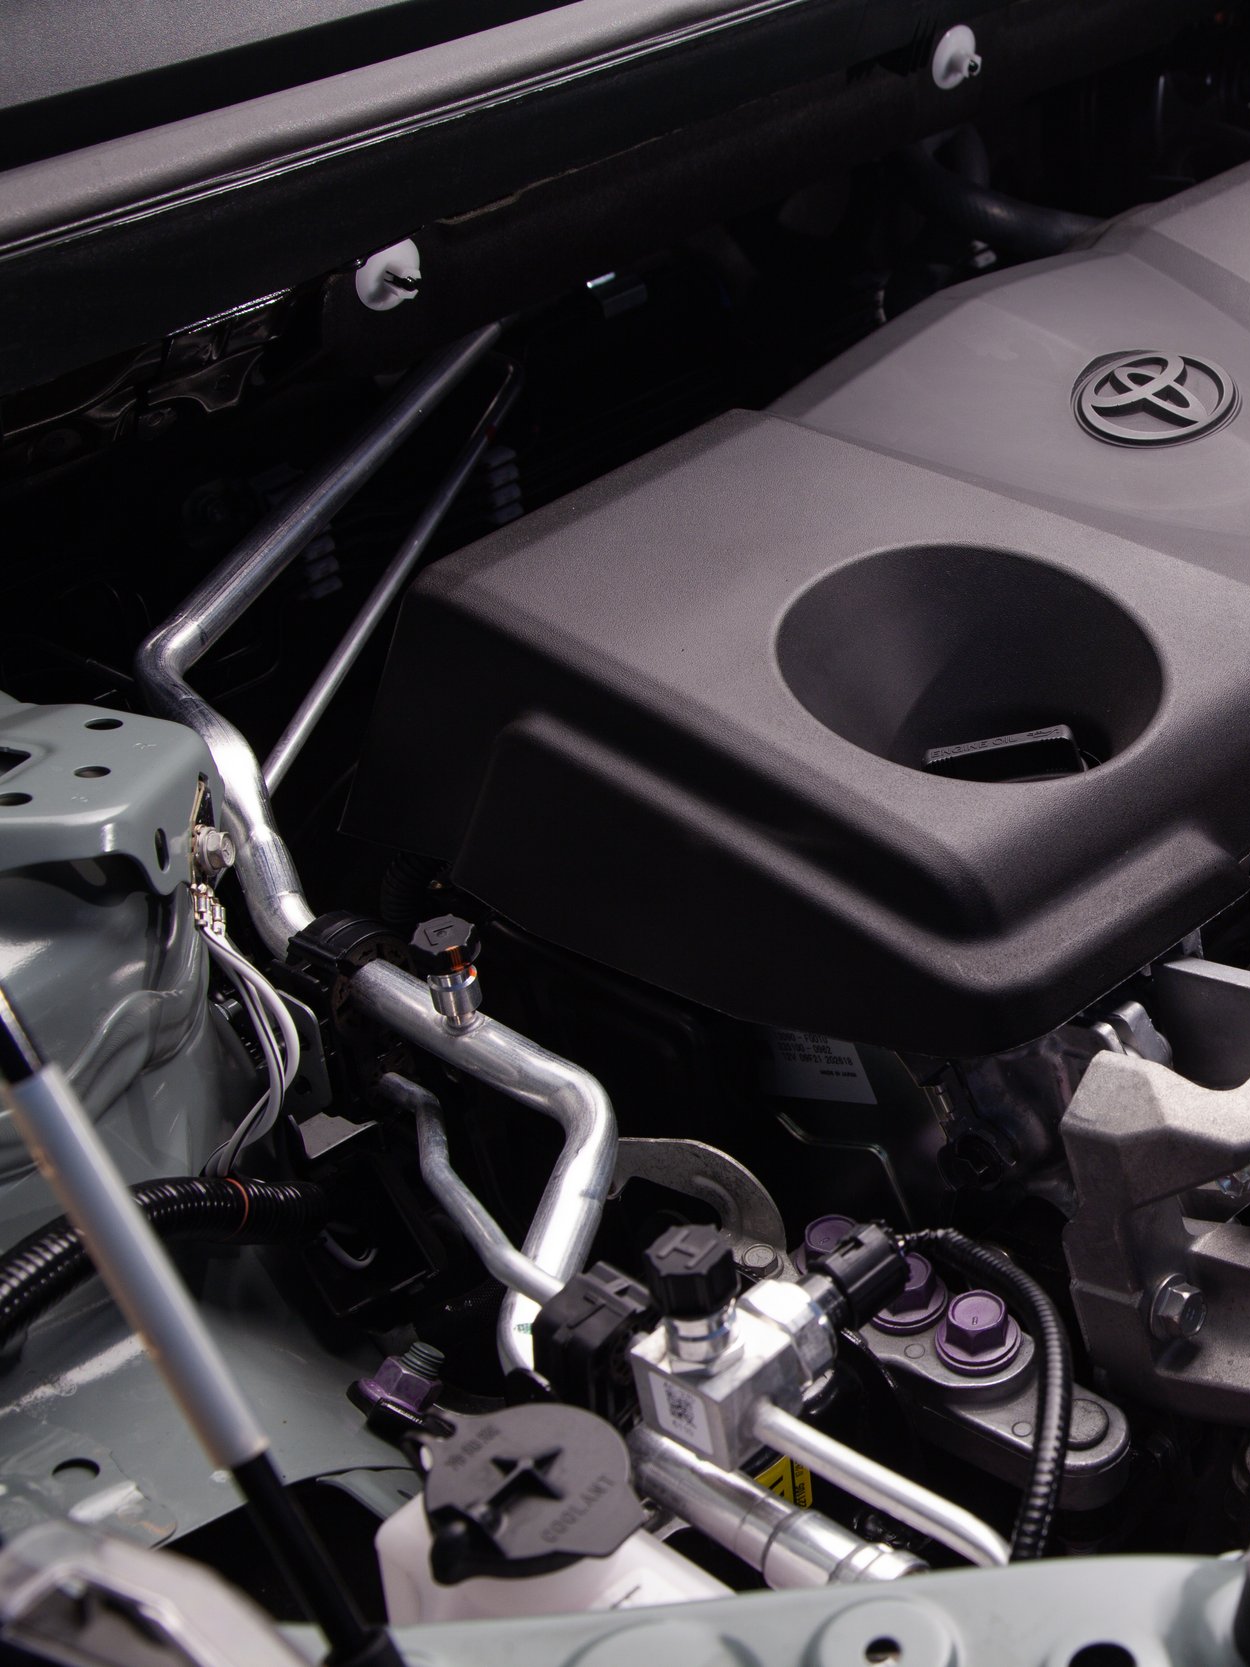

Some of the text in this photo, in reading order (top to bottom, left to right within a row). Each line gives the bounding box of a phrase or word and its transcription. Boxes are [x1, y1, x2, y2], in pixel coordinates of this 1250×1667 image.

[931, 736, 1018, 758] ENGINE OIL
[656, 1229, 718, 1270] H
[540, 1475, 615, 1543] COOLANT
